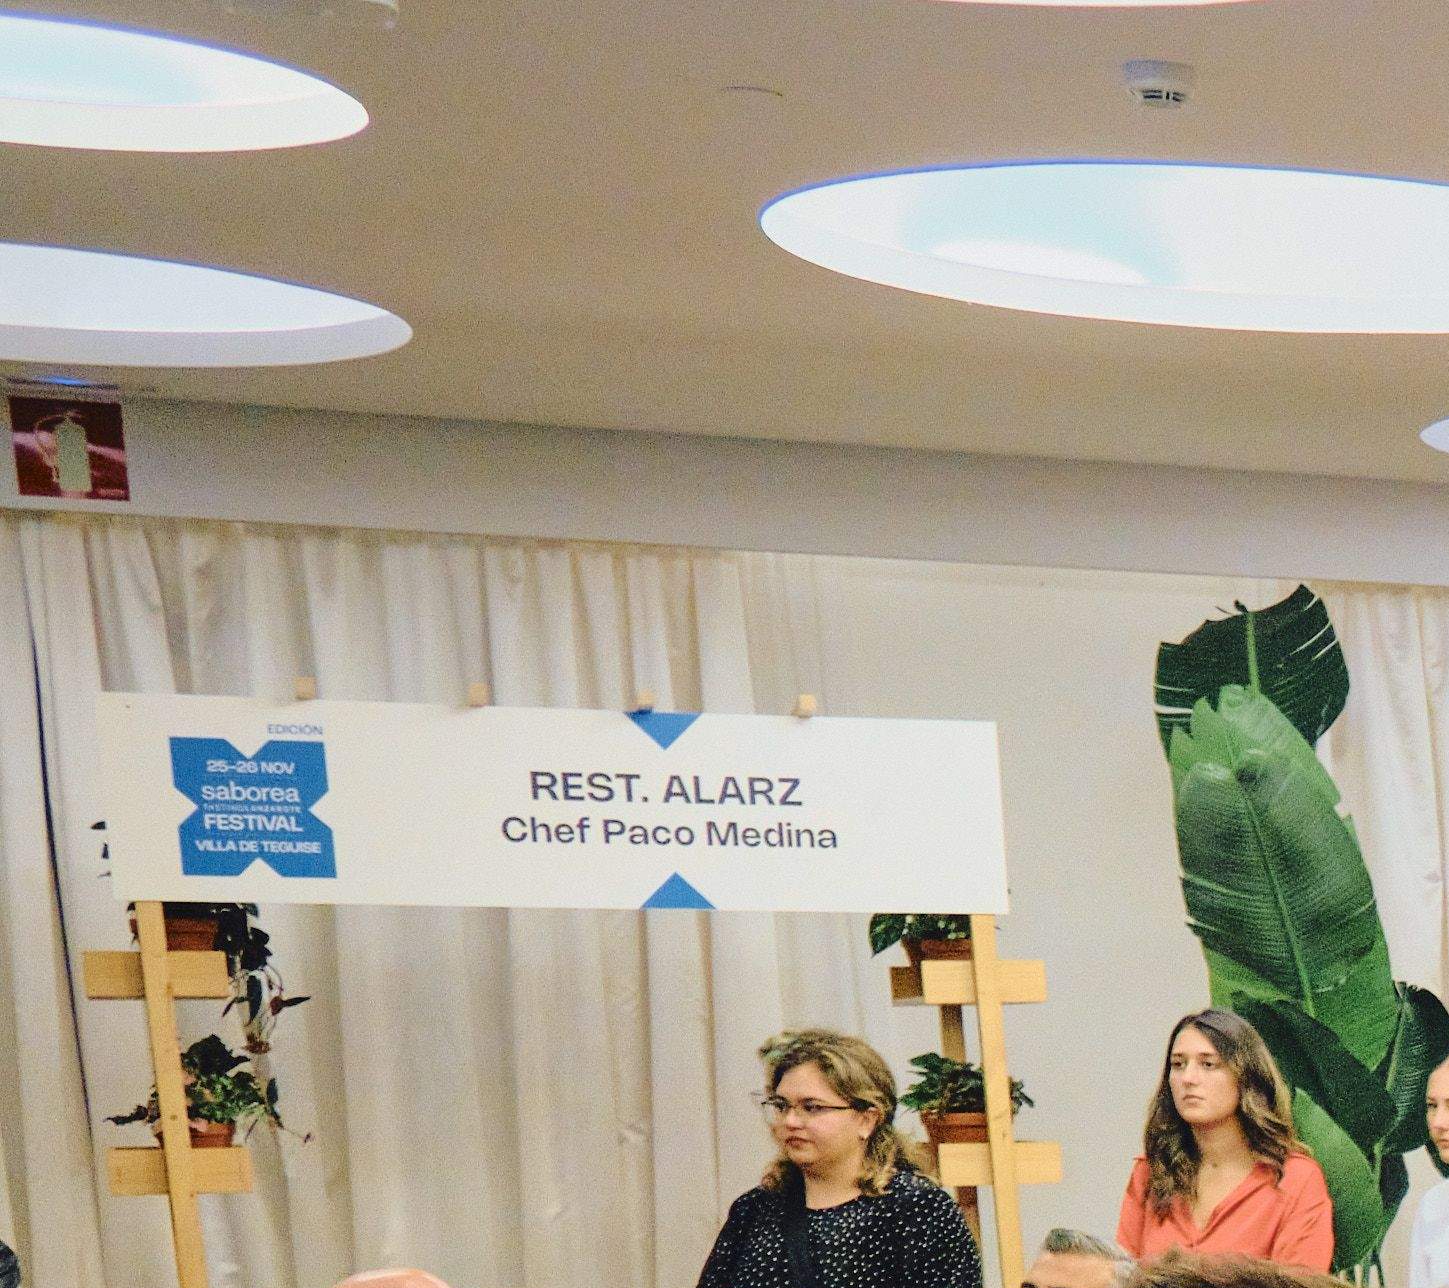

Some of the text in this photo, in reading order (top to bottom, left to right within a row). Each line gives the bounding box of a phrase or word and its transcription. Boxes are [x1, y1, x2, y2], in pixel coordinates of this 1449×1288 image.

[261, 761, 295, 775] NOV
[202, 781, 299, 802] saborea
[530, 771, 803, 806] REST. ALARZ
[204, 814, 303, 832] FESTIVAL
[501, 817, 837, 848] Chef Paco Medina
[196, 840, 321, 853] VILLA DE TEGUISE
